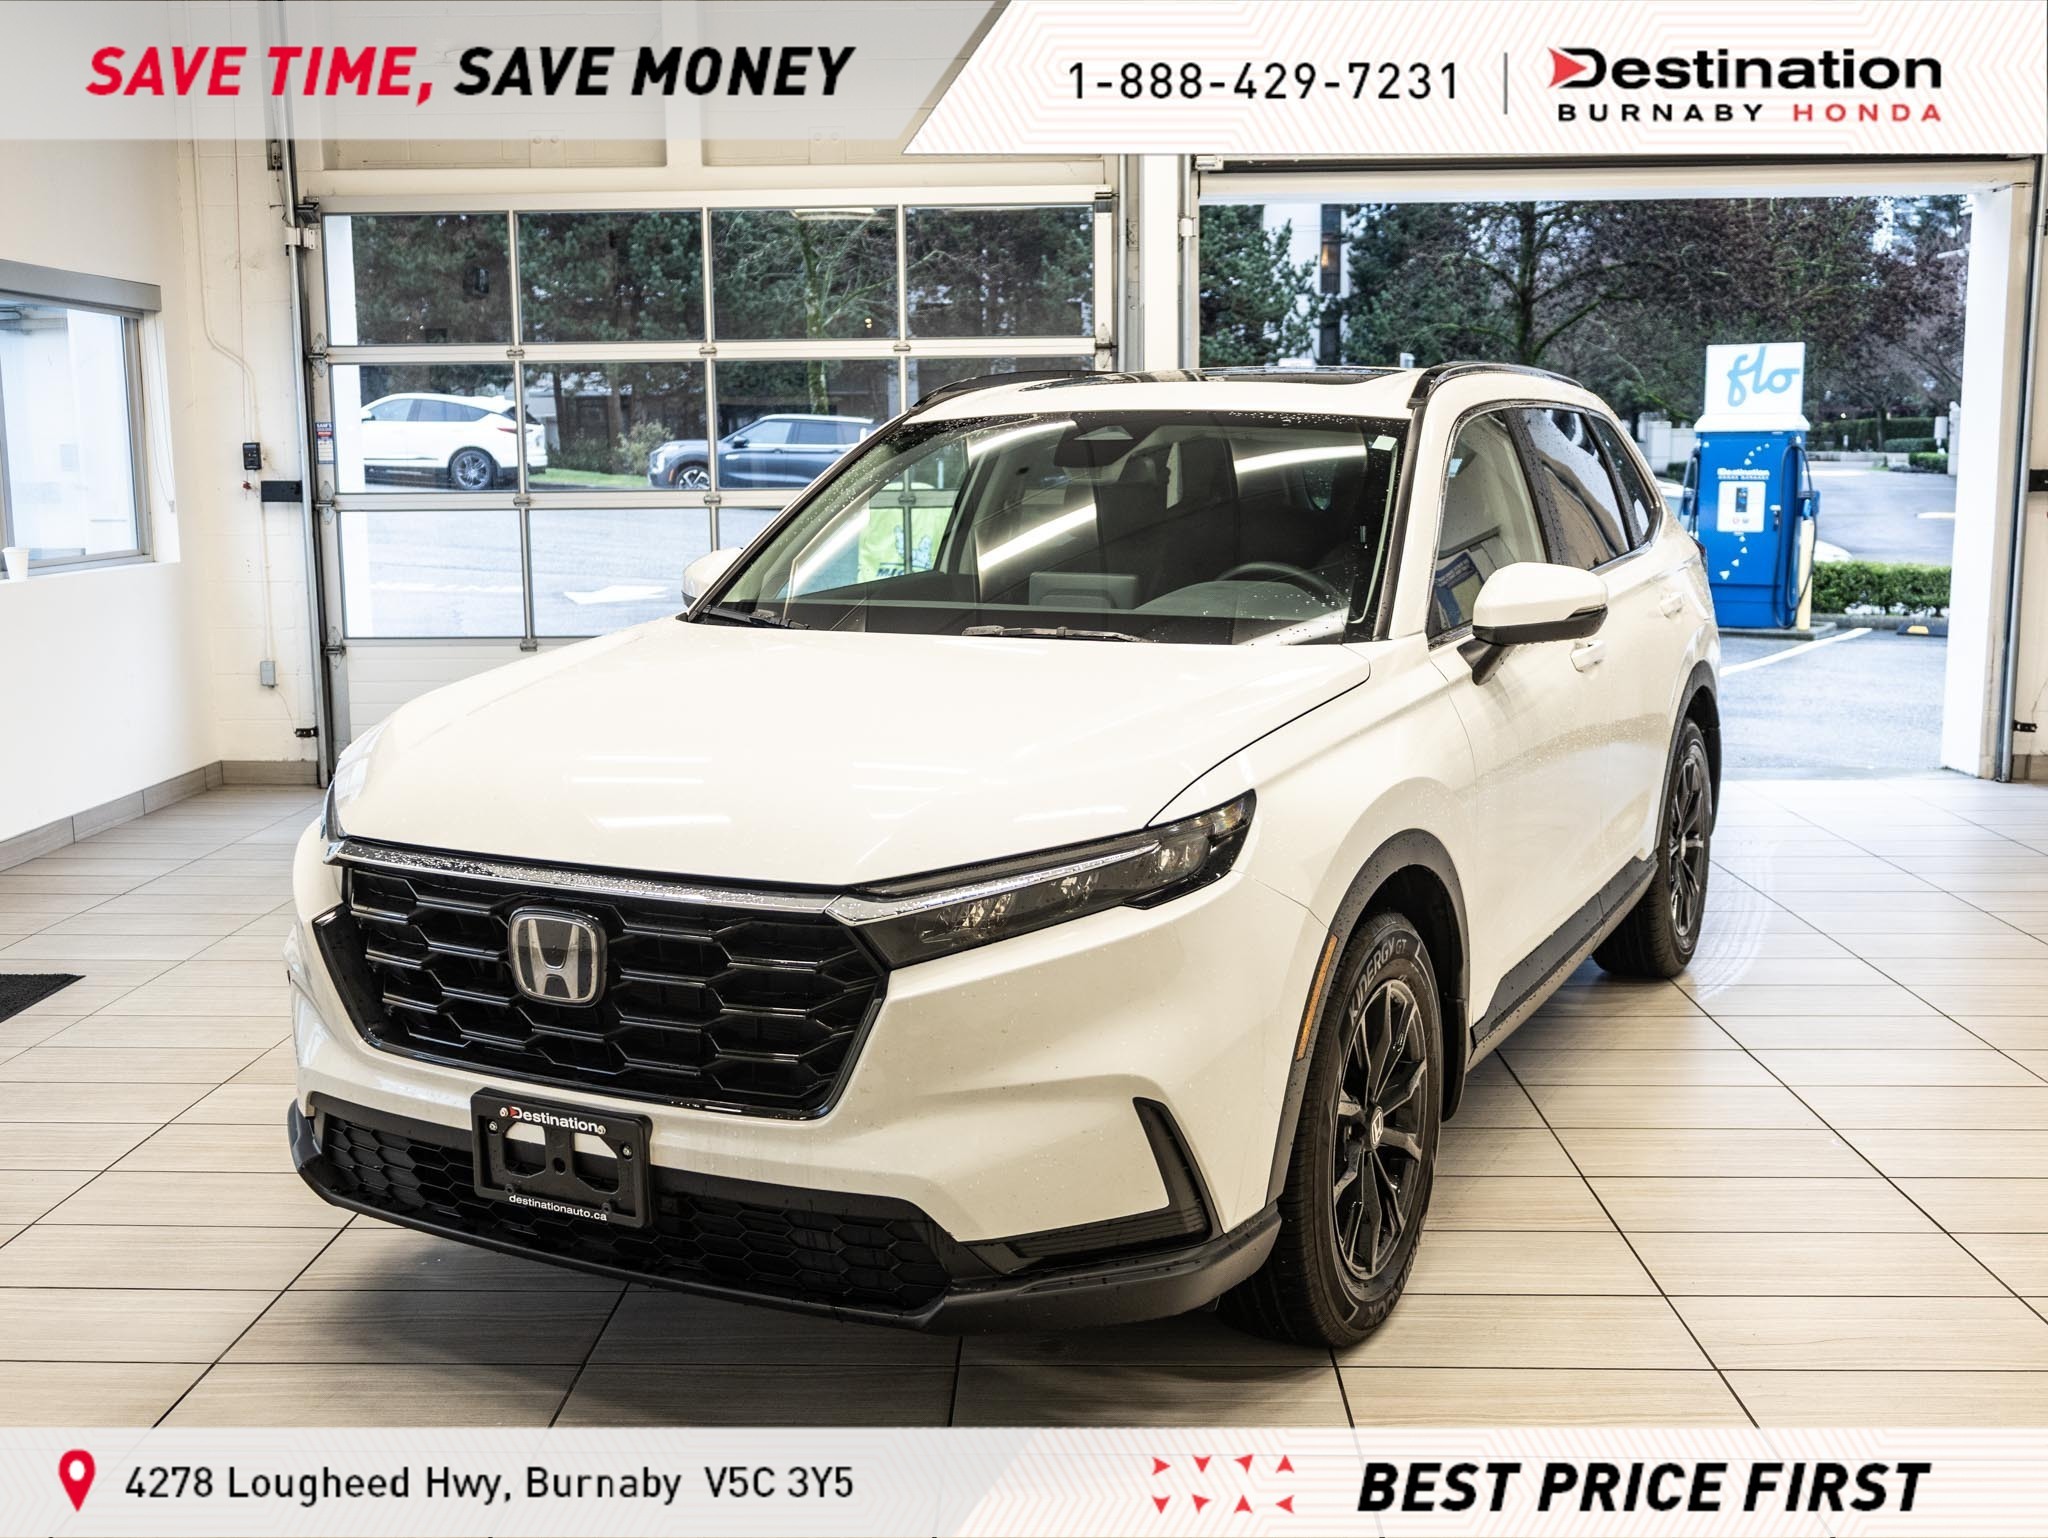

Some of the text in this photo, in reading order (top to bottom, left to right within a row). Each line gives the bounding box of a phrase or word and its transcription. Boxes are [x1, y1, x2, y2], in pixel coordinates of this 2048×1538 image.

[1727, 345, 1801, 407] flo
[508, 1106, 599, 1133] Destination
[509, 1194, 608, 1221] destinationauto.ca
